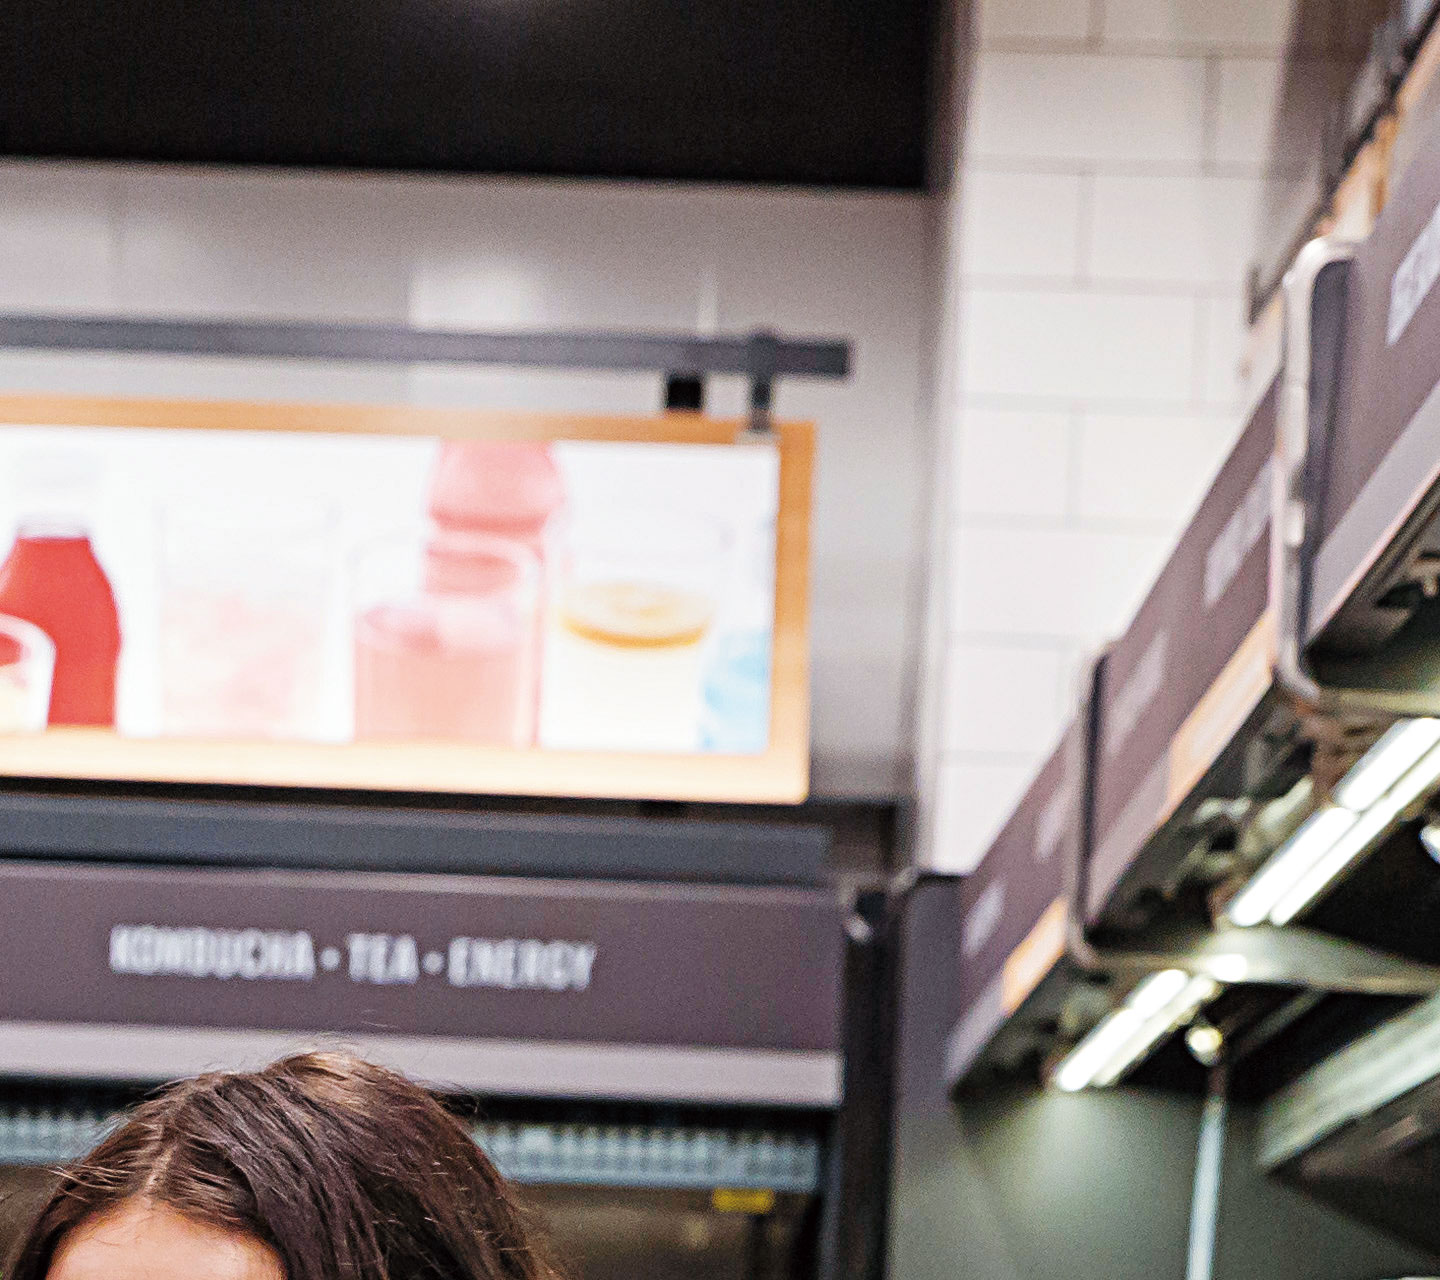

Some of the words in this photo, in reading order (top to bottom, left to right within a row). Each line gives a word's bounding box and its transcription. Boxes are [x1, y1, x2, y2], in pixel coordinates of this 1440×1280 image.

[110, 926, 315, 977] KOMBUCHA
[348, 934, 418, 982] TEA
[449, 937, 595, 988] ENERGY
